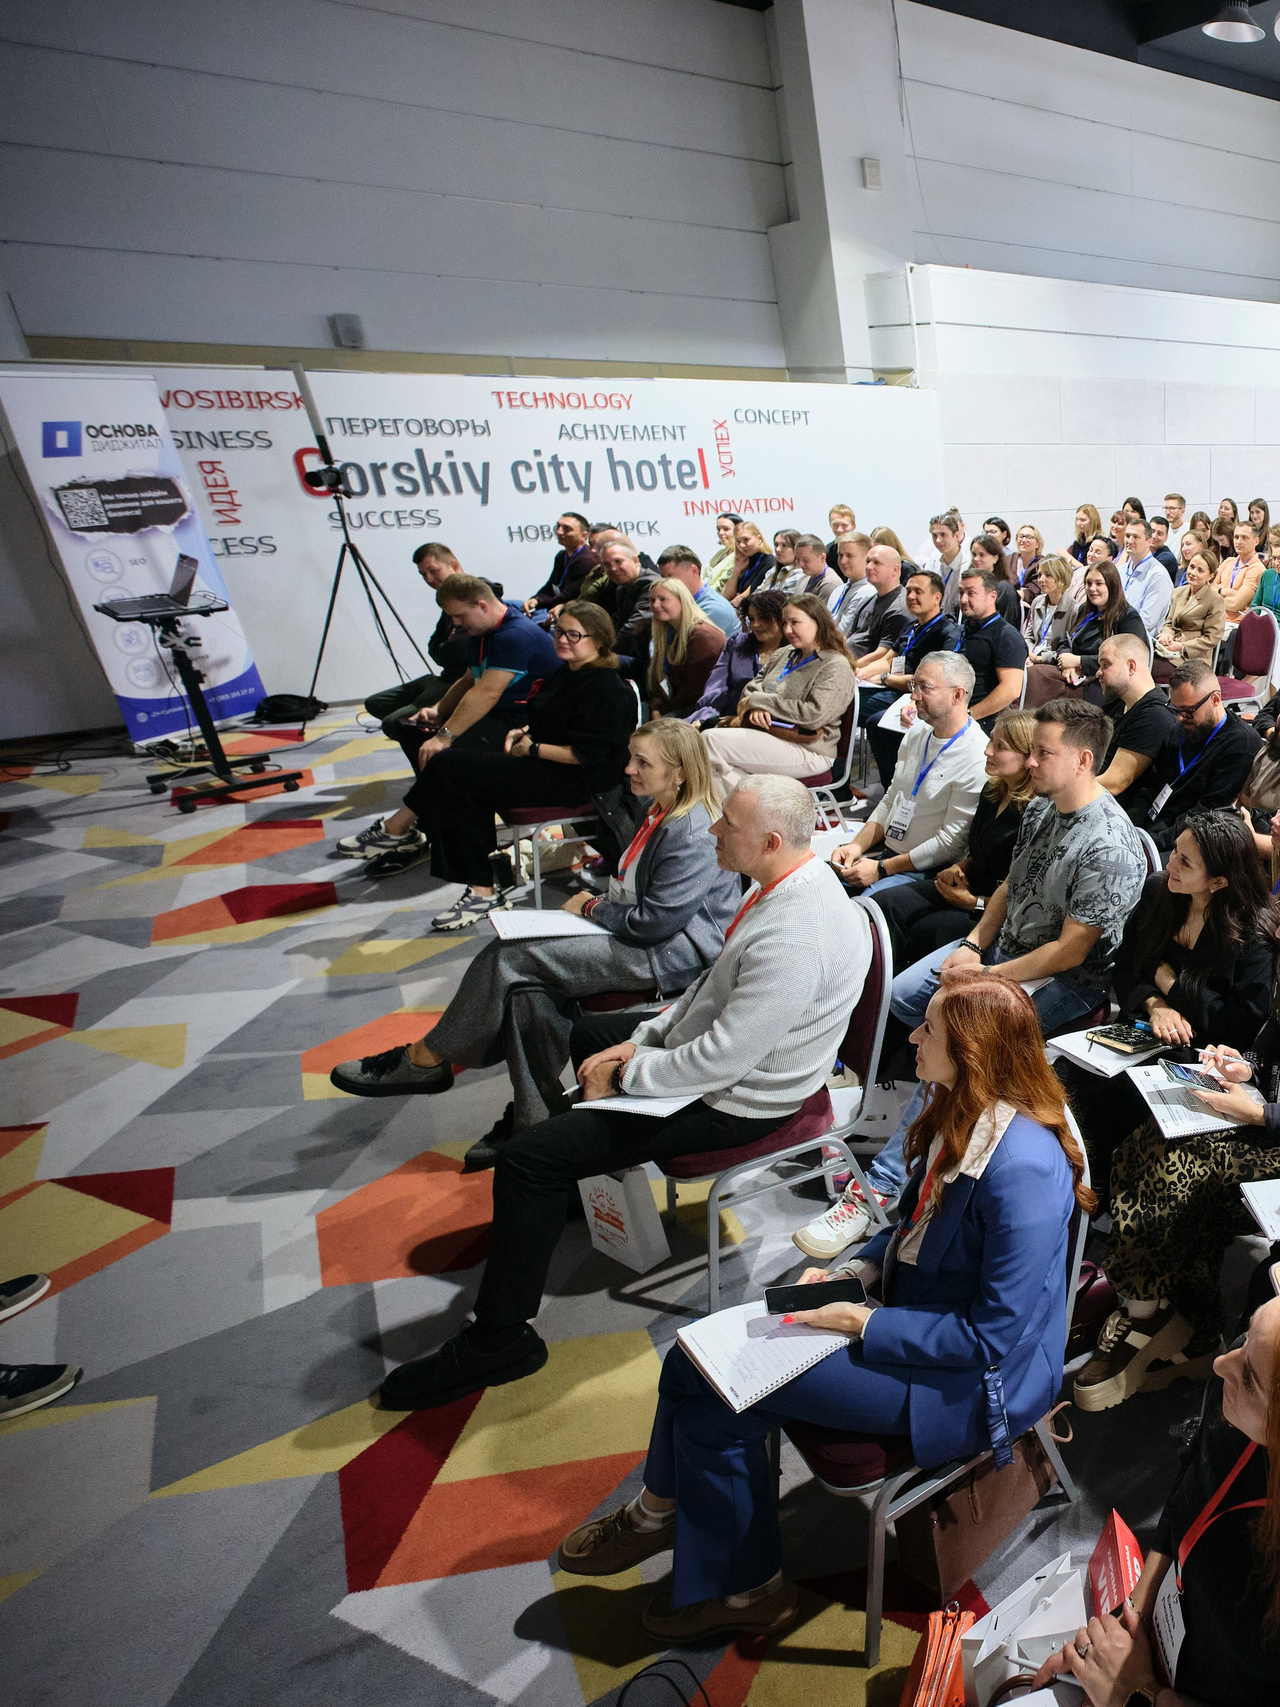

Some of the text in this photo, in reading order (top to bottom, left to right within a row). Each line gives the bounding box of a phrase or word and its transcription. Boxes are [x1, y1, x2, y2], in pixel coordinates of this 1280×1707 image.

[491, 391, 633, 410] TECHNOLOGY
[733, 408, 810, 425] CONCEPT
[86, 424, 159, 438] ОСНОВА
[326, 417, 491, 437] ПЕРЕГОВОРЫ
[558, 423, 687, 441] ACHIVEMENT
[91, 438, 164, 452] ДИДЖИТАЛ
[713, 419, 735, 478] УСПЕХ
[293, 447, 710, 506] Gorskiy city hotel
[198, 460, 242, 525] ИДЕЯ
[683, 497, 794, 516] INNOVATION
[327, 509, 442, 530] SUCCESS
[129, 558, 146, 566] SEO
